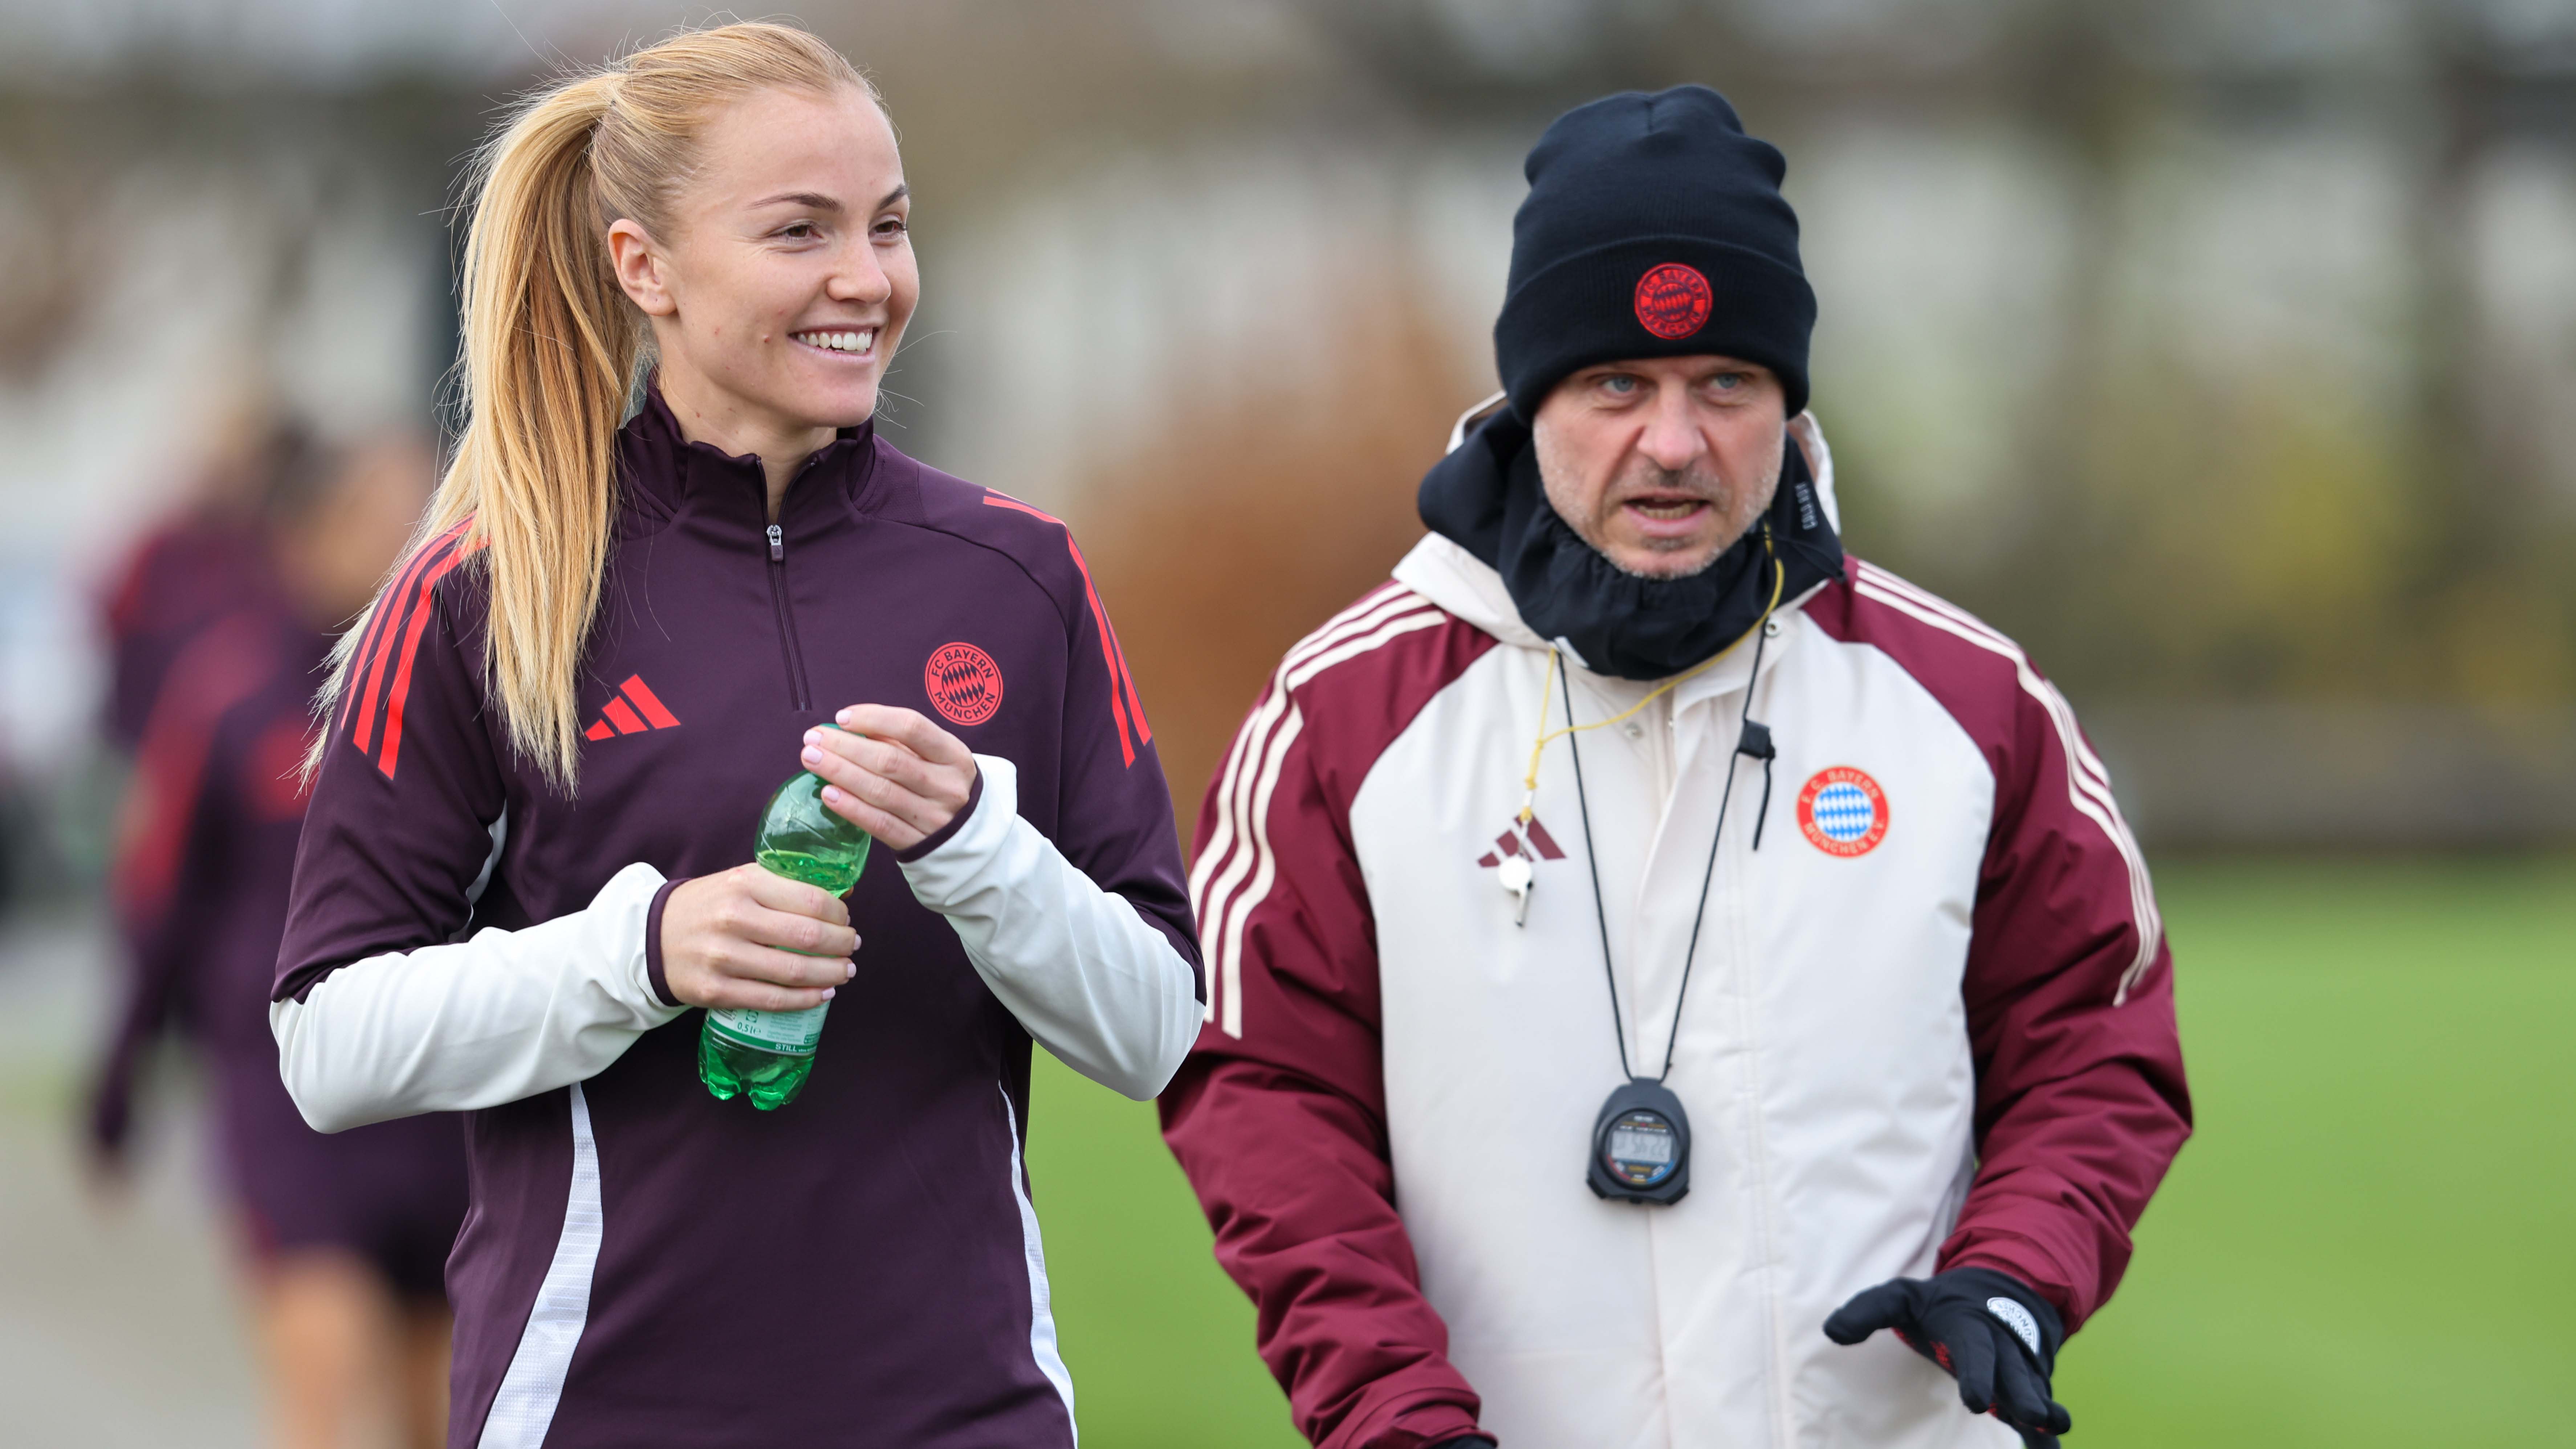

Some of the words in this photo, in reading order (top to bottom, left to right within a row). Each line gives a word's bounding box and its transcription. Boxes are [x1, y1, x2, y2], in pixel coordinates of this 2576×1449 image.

[932, 659, 944, 677] FC
[944, 649, 994, 679] BAYERN
[1827, 770, 1879, 798] BAYERN
[775, 1043, 797, 1052] STILL
